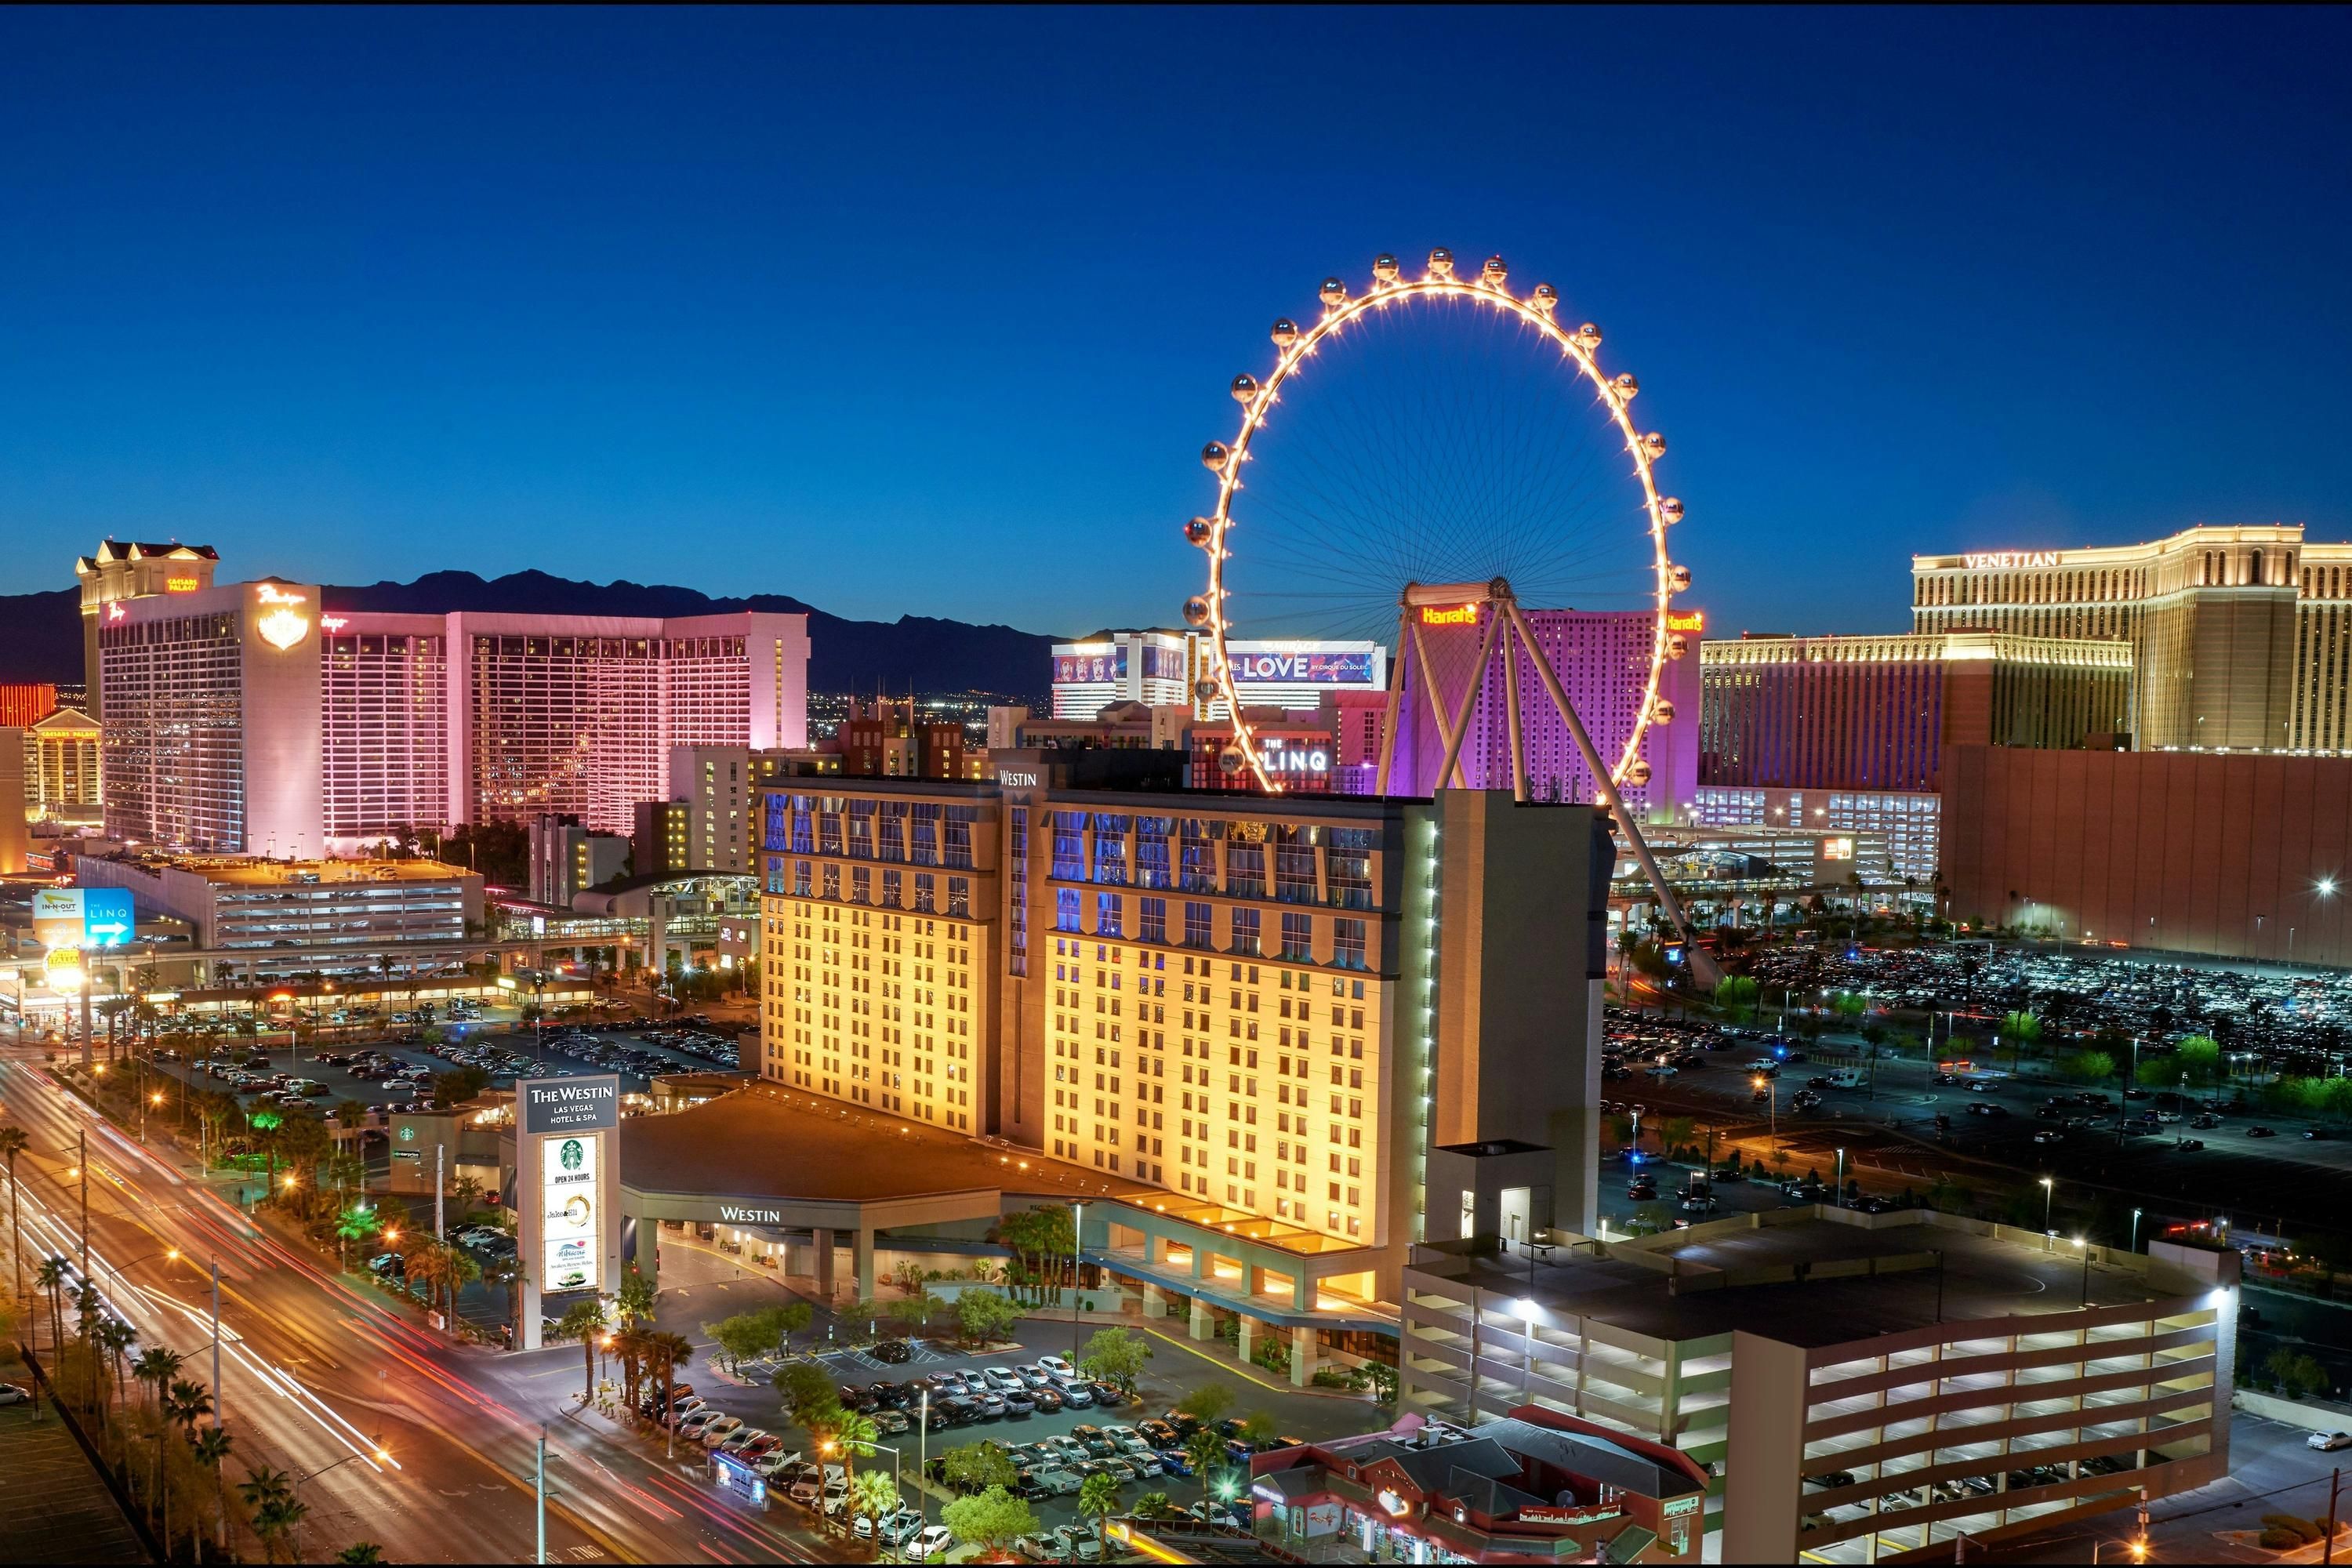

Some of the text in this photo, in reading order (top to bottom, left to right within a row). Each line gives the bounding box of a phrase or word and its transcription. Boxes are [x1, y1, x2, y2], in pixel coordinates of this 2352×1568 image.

[1965, 552, 2058, 568] VENETIAN
[321, 614, 348, 633] ingo
[1243, 657, 1308, 677] LOVE
[1265, 739, 1282, 749] THE
[1264, 750, 1327, 771] LINQ
[1000, 769, 1036, 786] WESTIN
[90, 909, 127, 918] LINQ
[532, 1087, 613, 1104] THE WESTIN
[570, 1104, 593, 1112] VEGAS
[550, 1115, 574, 1123] HOTEL
[720, 1207, 780, 1222] WESTIN
[567, 1544, 604, 1561] ONLY
